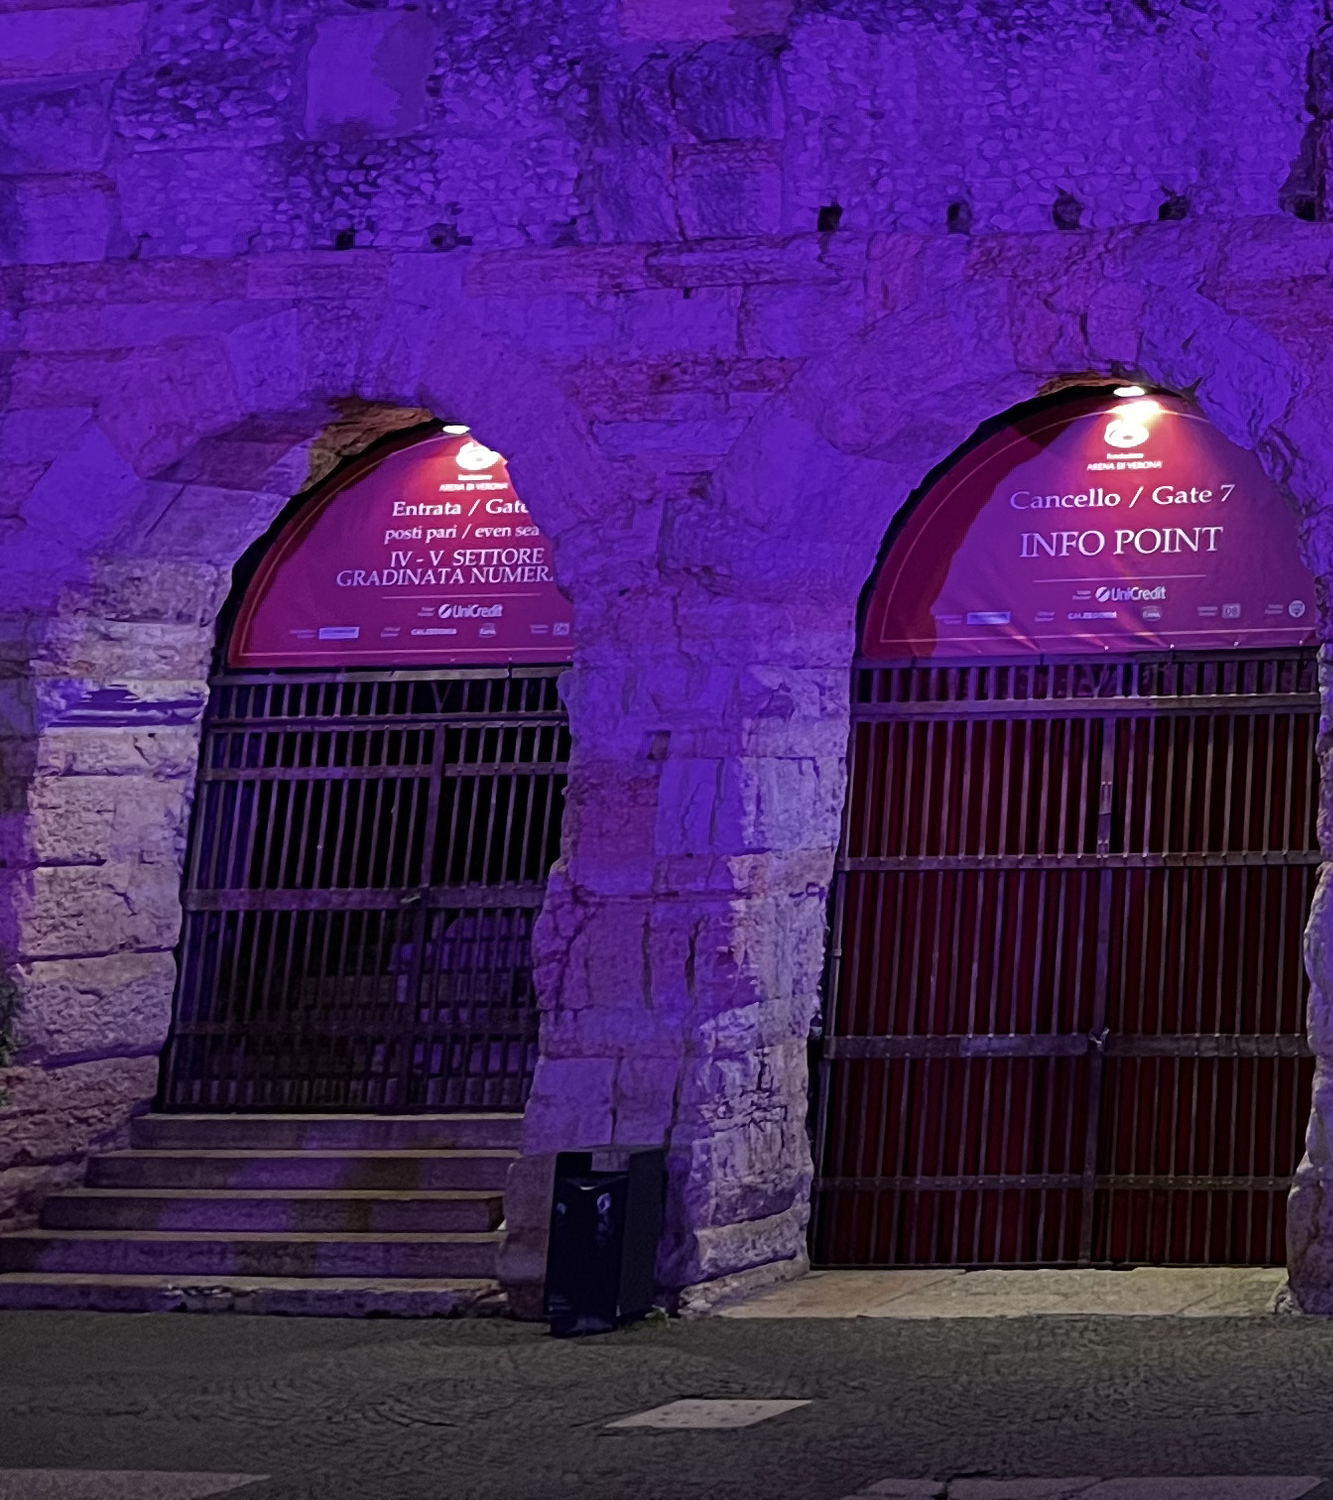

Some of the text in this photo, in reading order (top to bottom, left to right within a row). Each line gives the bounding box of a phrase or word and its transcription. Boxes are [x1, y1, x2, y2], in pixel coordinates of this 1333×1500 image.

[1010, 488, 1121, 510] Cancello
[1152, 485, 1213, 505] Gate
[1220, 484, 1236, 502] 7
[392, 501, 461, 517] Entrata
[384, 526, 422, 544] posti
[425, 525, 457, 543] pari
[475, 526, 511, 538] even
[1019, 527, 1224, 558] INFO POINT
[390, 550, 413, 567] IV
[429, 550, 444, 567] V
[453, 548, 545, 566] SETTORE
[336, 566, 554, 587] GRADINATA NUMER
[1111, 586, 1166, 601] UniCredit
